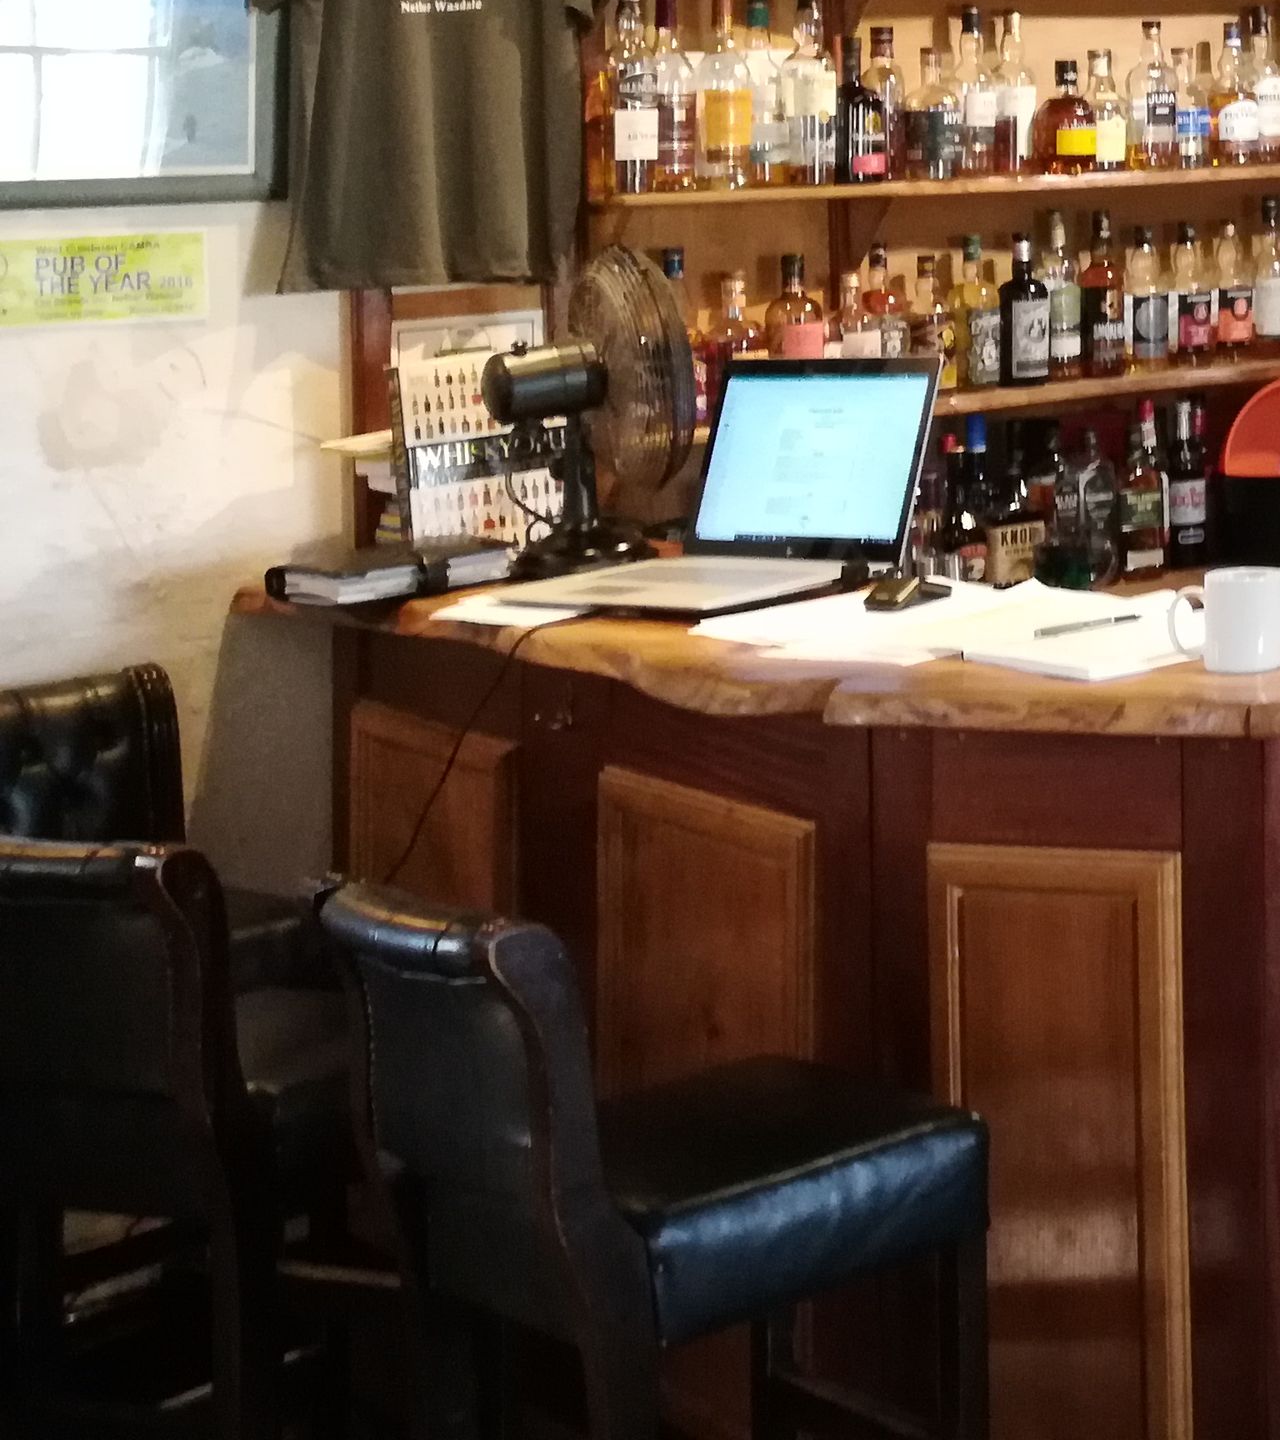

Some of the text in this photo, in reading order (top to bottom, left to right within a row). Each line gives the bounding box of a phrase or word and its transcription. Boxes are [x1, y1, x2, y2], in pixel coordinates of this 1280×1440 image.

[120, 240, 160, 250] CAMRA
[34, 253, 127, 276] PUB OF
[35, 275, 81, 297] THE
[89, 271, 150, 294] YEAR
